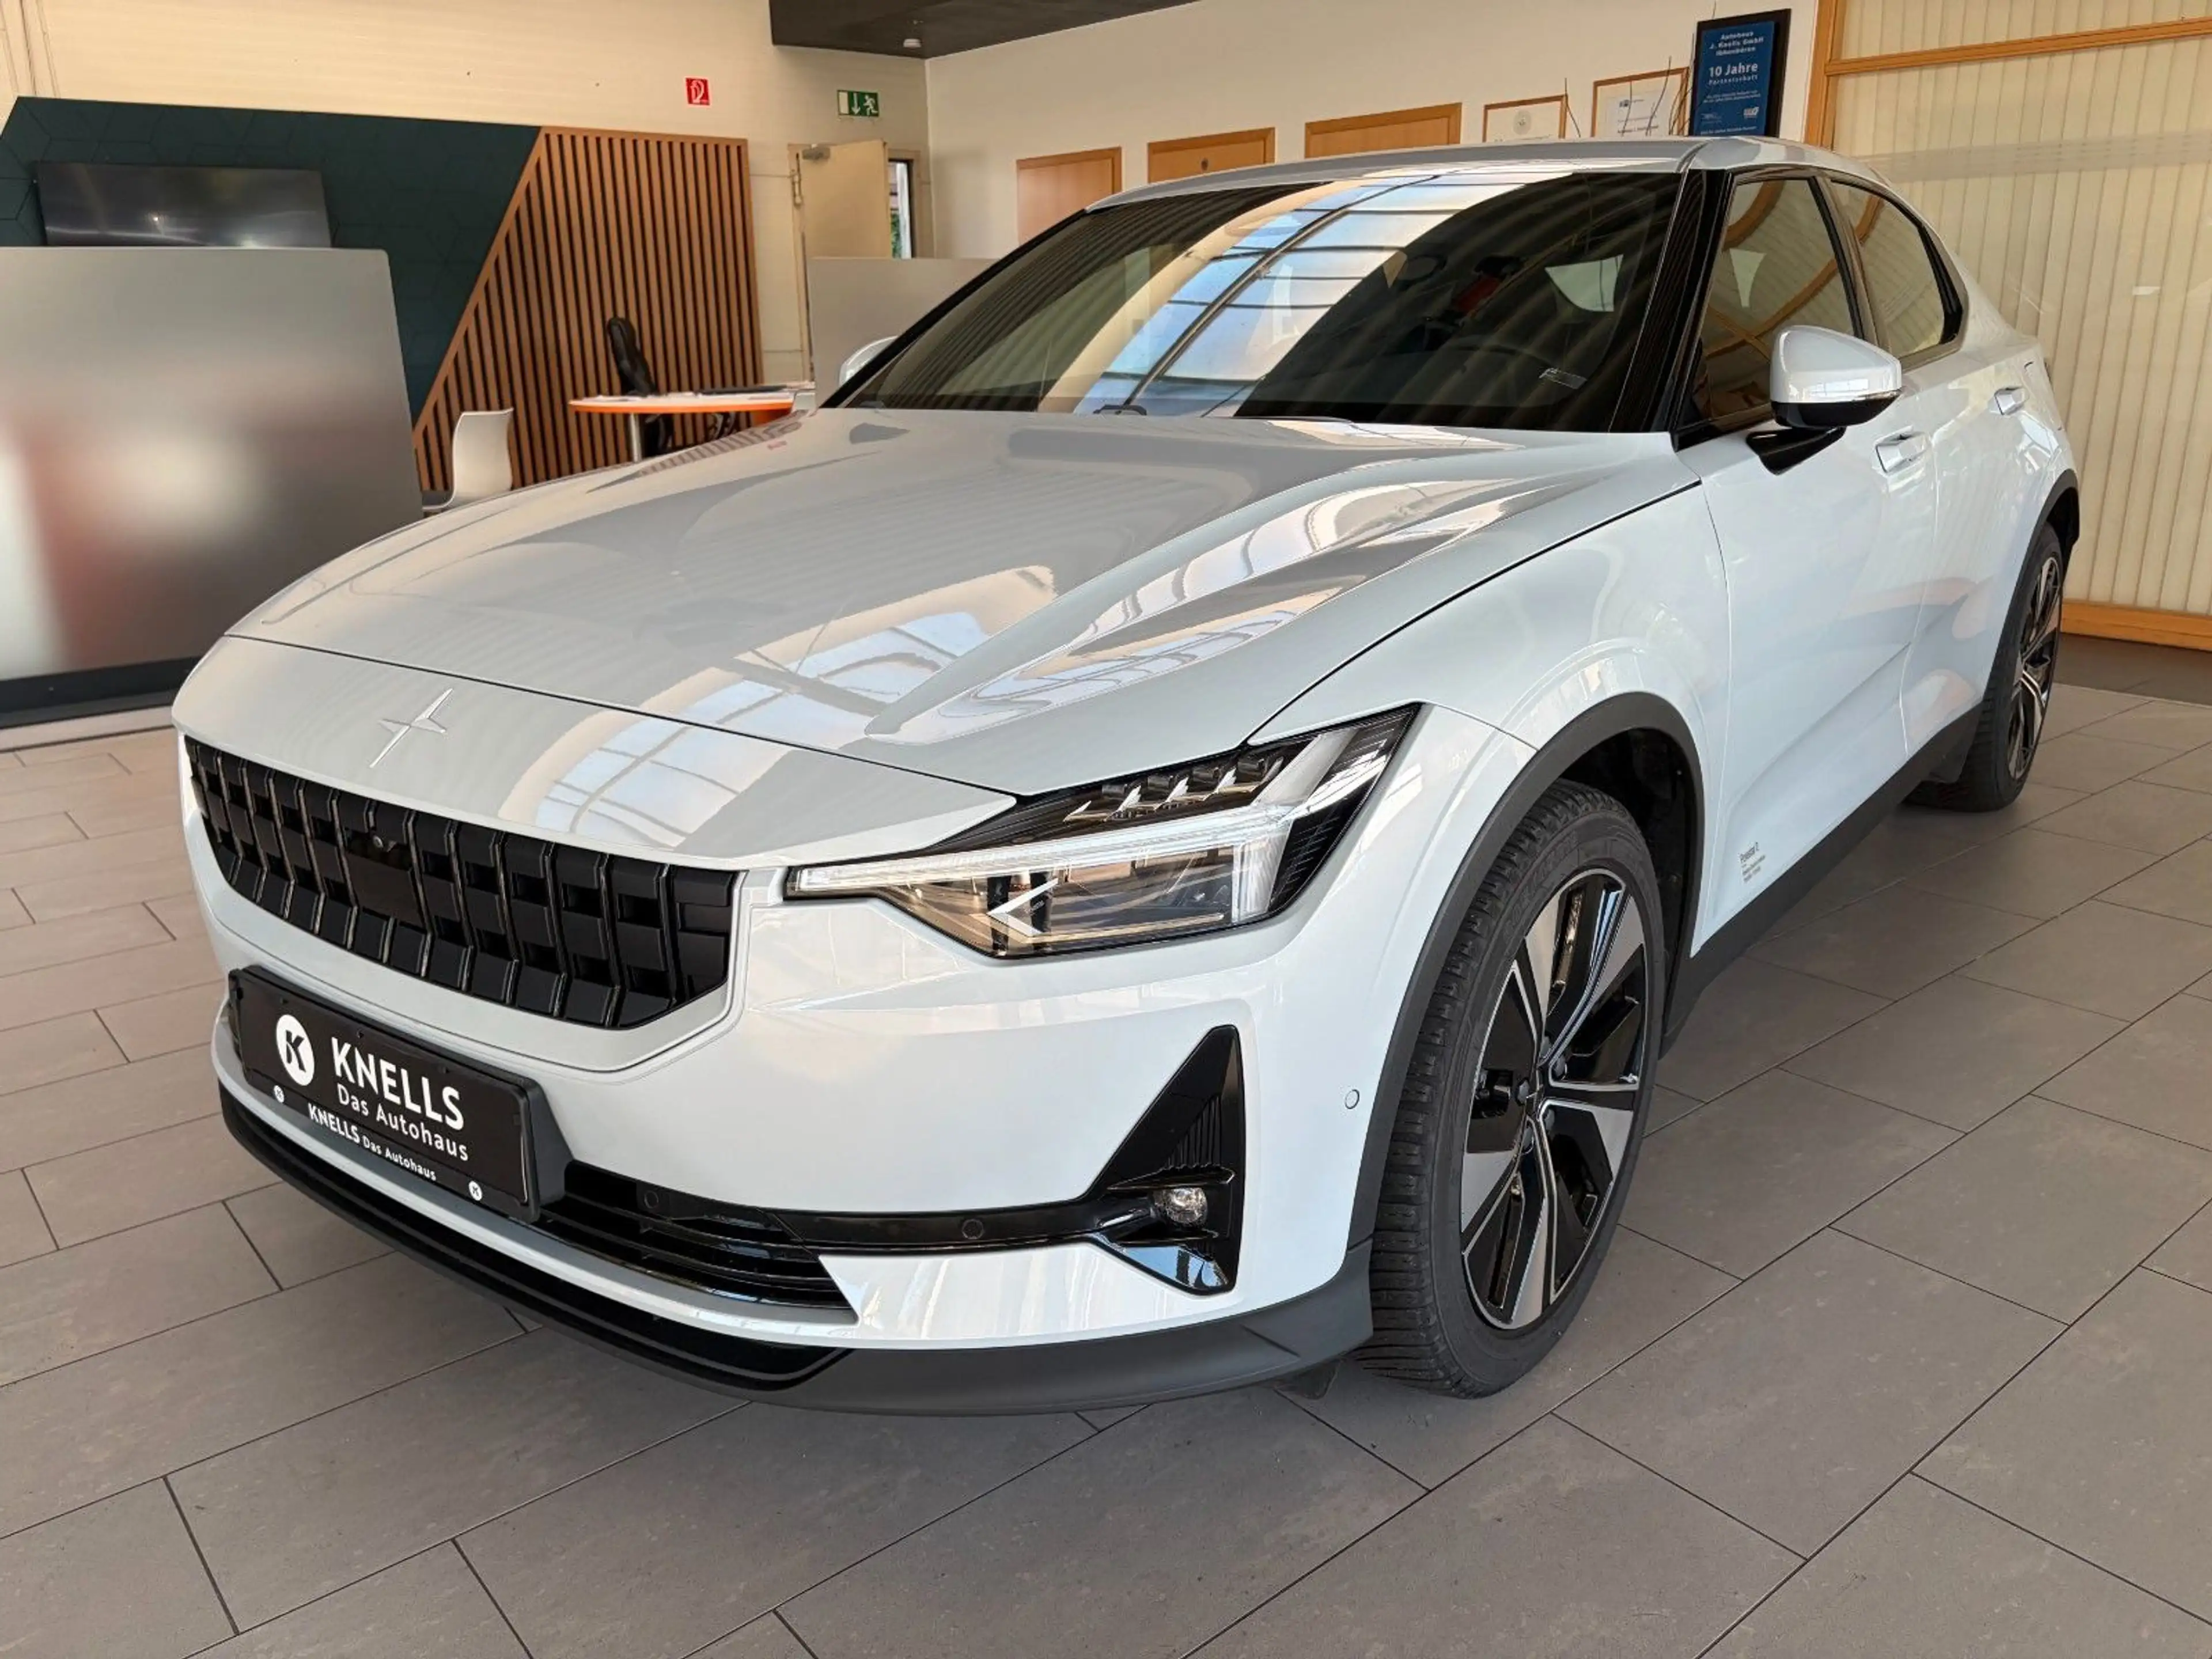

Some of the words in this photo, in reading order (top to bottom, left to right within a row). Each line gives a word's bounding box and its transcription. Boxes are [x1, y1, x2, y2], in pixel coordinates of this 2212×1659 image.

[1709, 66, 1722, 78] 10
[1725, 62, 1758, 76] Jahre
[1743, 36, 1764, 45] GmbH
[331, 1037, 464, 1130] KNELLS
[337, 1083, 369, 1116] Das
[376, 1103, 468, 1161] Autohaus
[308, 1103, 360, 1144] KNELLS
[362, 1135, 382, 1154] Das
[385, 1147, 437, 1181] Autohaus
